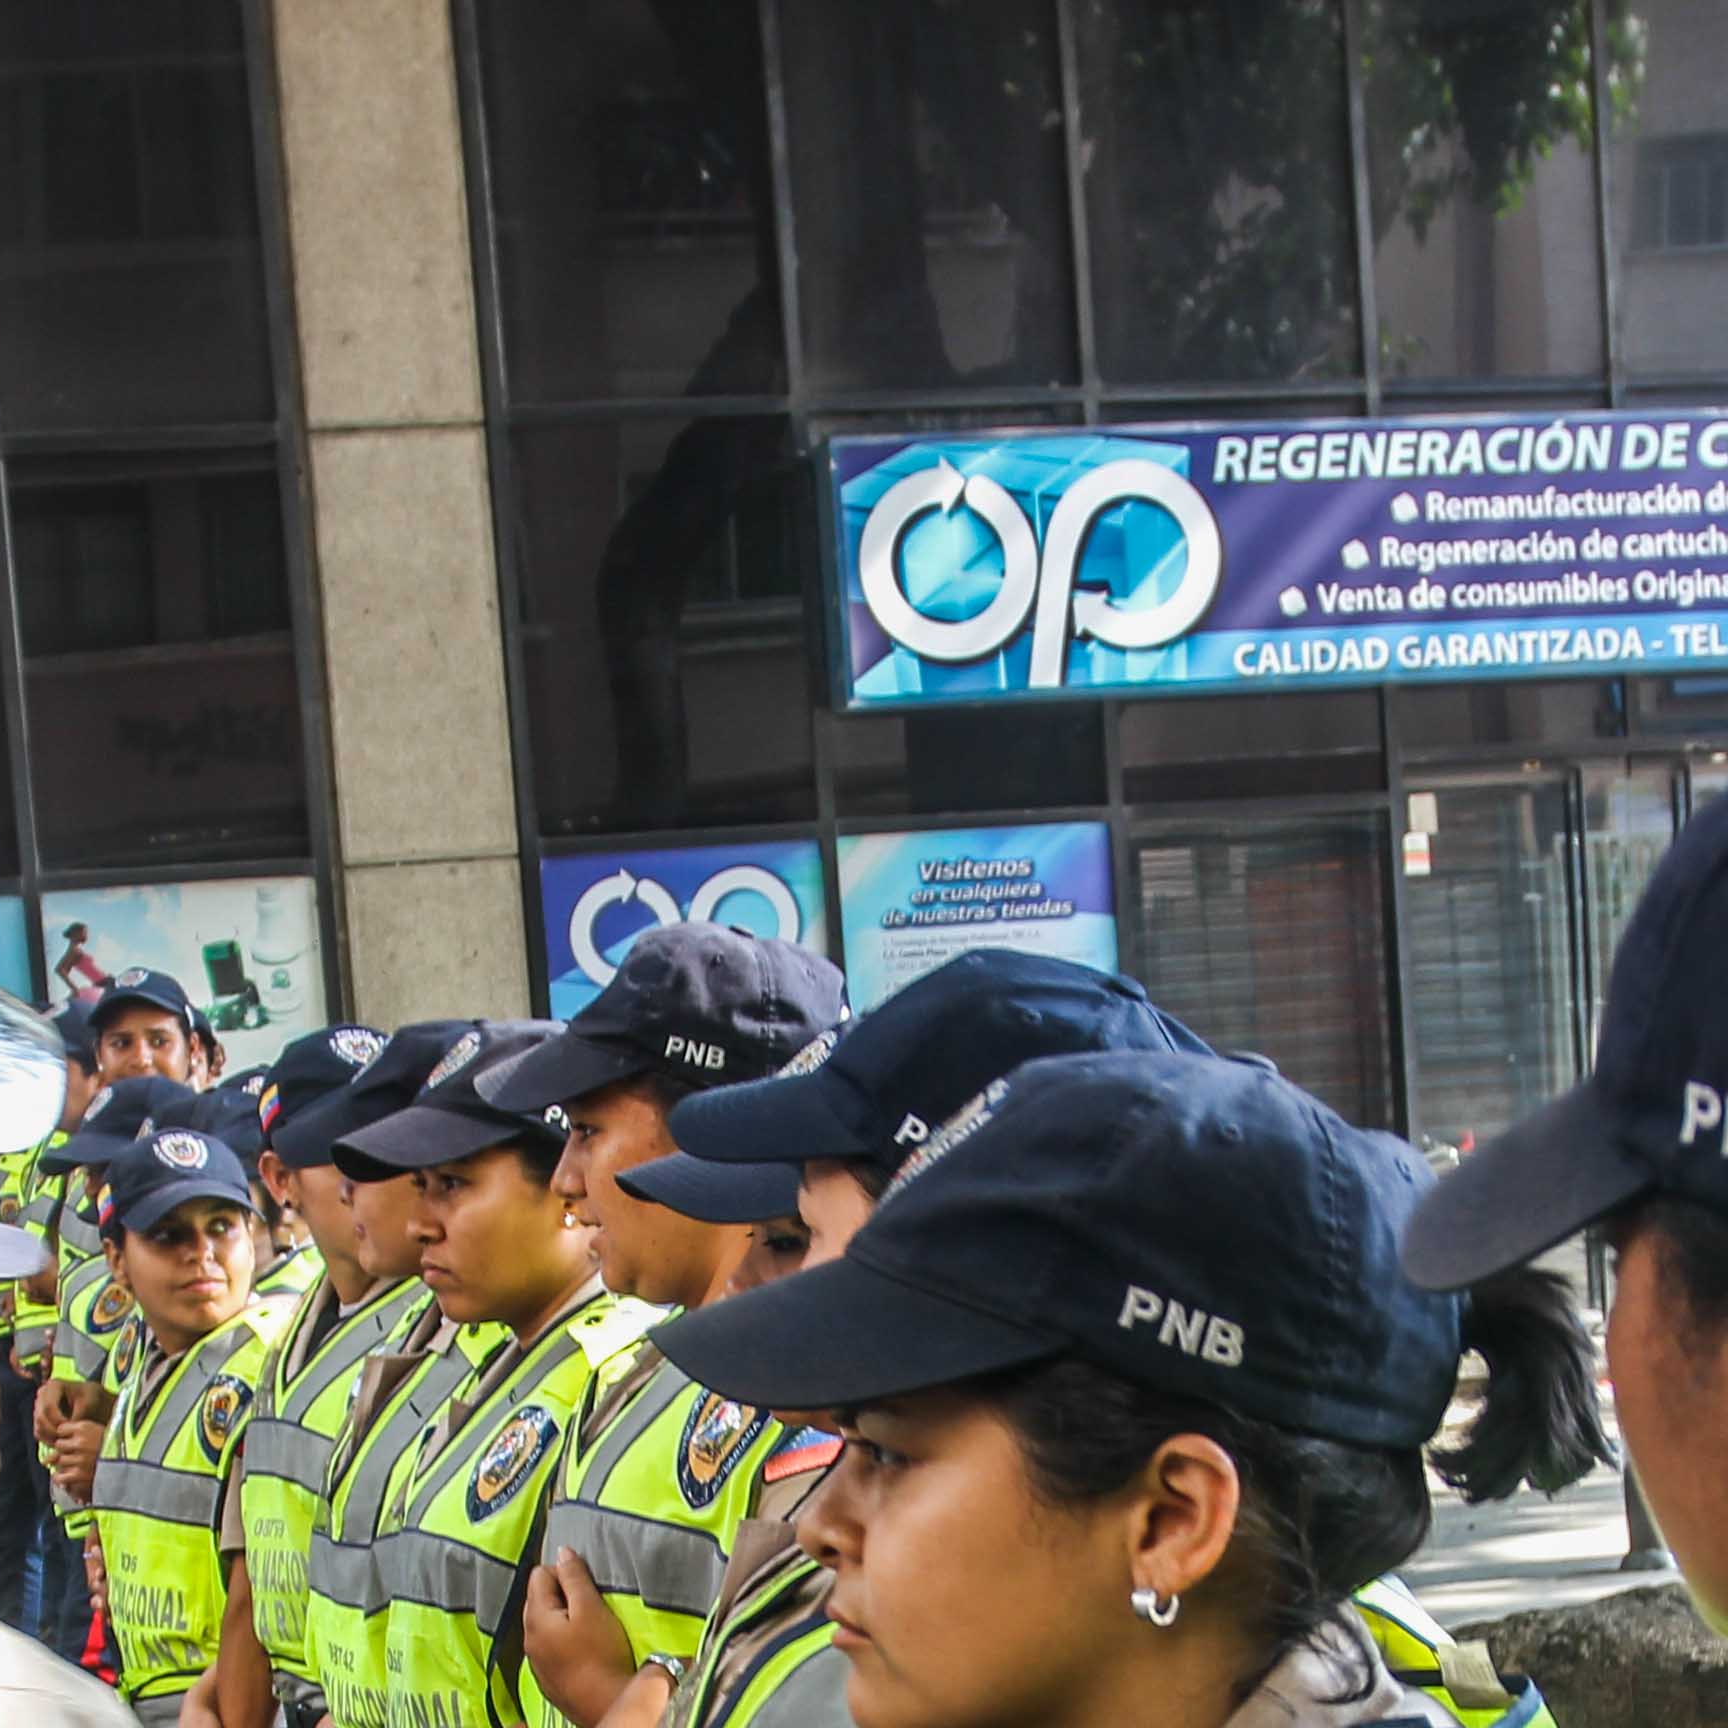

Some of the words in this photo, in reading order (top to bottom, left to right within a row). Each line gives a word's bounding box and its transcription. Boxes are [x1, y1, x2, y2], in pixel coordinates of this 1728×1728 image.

[1212, 419, 1614, 483] REGENERACIÓN
[1620, 422, 1691, 470] DE
[1425, 481, 1701, 523] Remanufacturación
[1379, 528, 1576, 573] Regeneración
[1581, 527, 1619, 561] de
[1315, 582, 1403, 614] Venta
[1408, 577, 1449, 611] de
[1450, 572, 1630, 609] consumibles
[1232, 635, 1390, 678] CALIDAD
[1395, 625, 1645, 671] GARANTIZADA
[1669, 622, 1728, 658] TEL
[882, 908, 907, 927] de
[912, 904, 997, 924] nuestras
[1001, 897, 1073, 920] tiendas
[910, 889, 935, 906] en
[940, 881, 1043, 904] cualquiera
[663, 1034, 727, 1070] PNB
[1116, 1285, 1246, 1370] PNB
